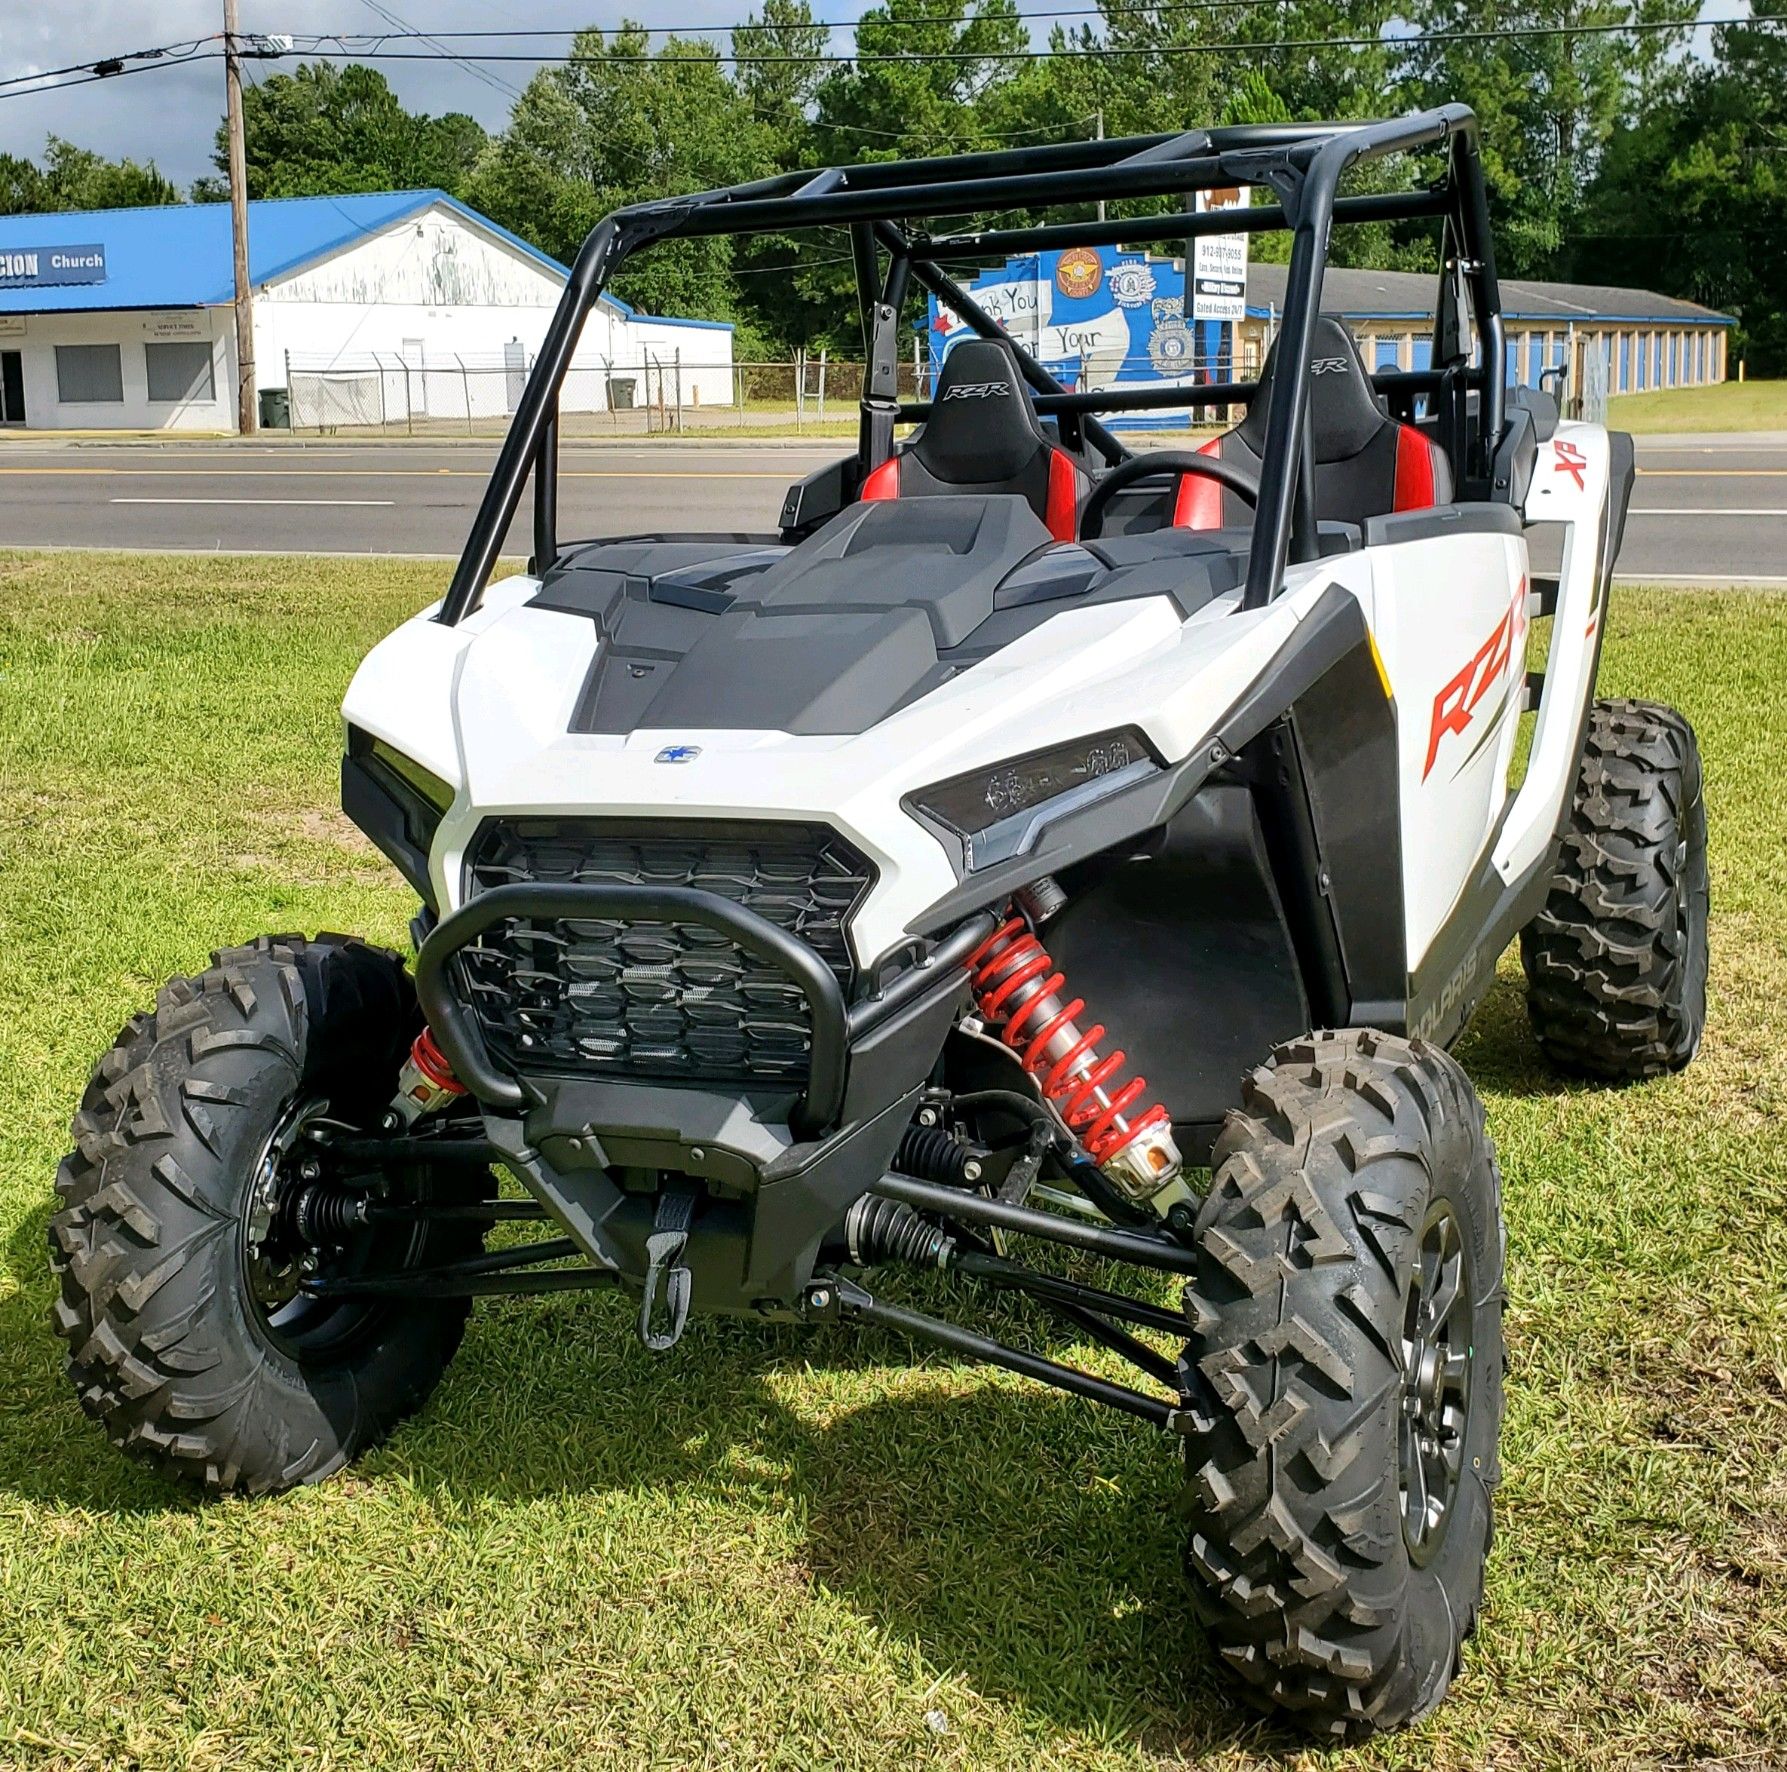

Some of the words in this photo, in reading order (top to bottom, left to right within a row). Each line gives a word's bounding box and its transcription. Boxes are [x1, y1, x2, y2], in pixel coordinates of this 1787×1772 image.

[51, 253, 103, 268] Church
[1005, 287, 1038, 313] You
[1213, 303, 1231, 316] Access
[1056, 326, 1103, 354] Your
[942, 381, 1010, 401] RZR
[1554, 439, 1587, 493] XP
[1421, 572, 1526, 787] RZR
